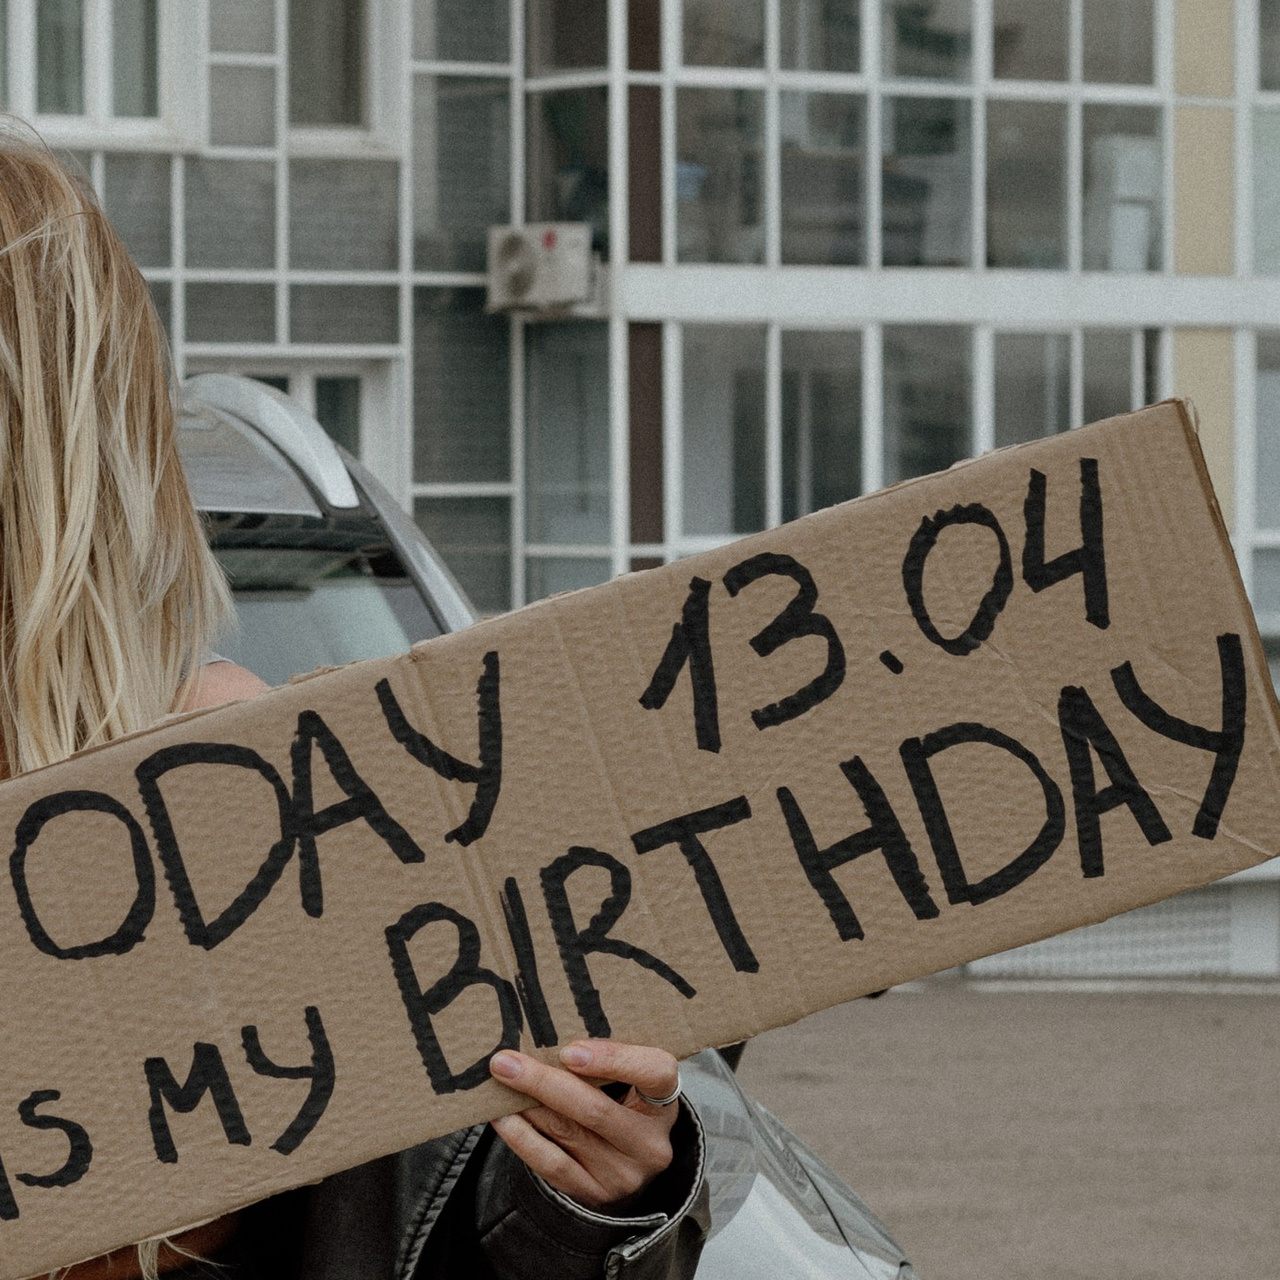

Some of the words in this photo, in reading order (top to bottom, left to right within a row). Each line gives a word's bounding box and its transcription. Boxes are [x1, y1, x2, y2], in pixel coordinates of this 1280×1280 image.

[638, 457, 1111, 754] 13.04
[142, 1006, 336, 1164] MY
[385, 634, 1246, 1096] BIRTHDAY
